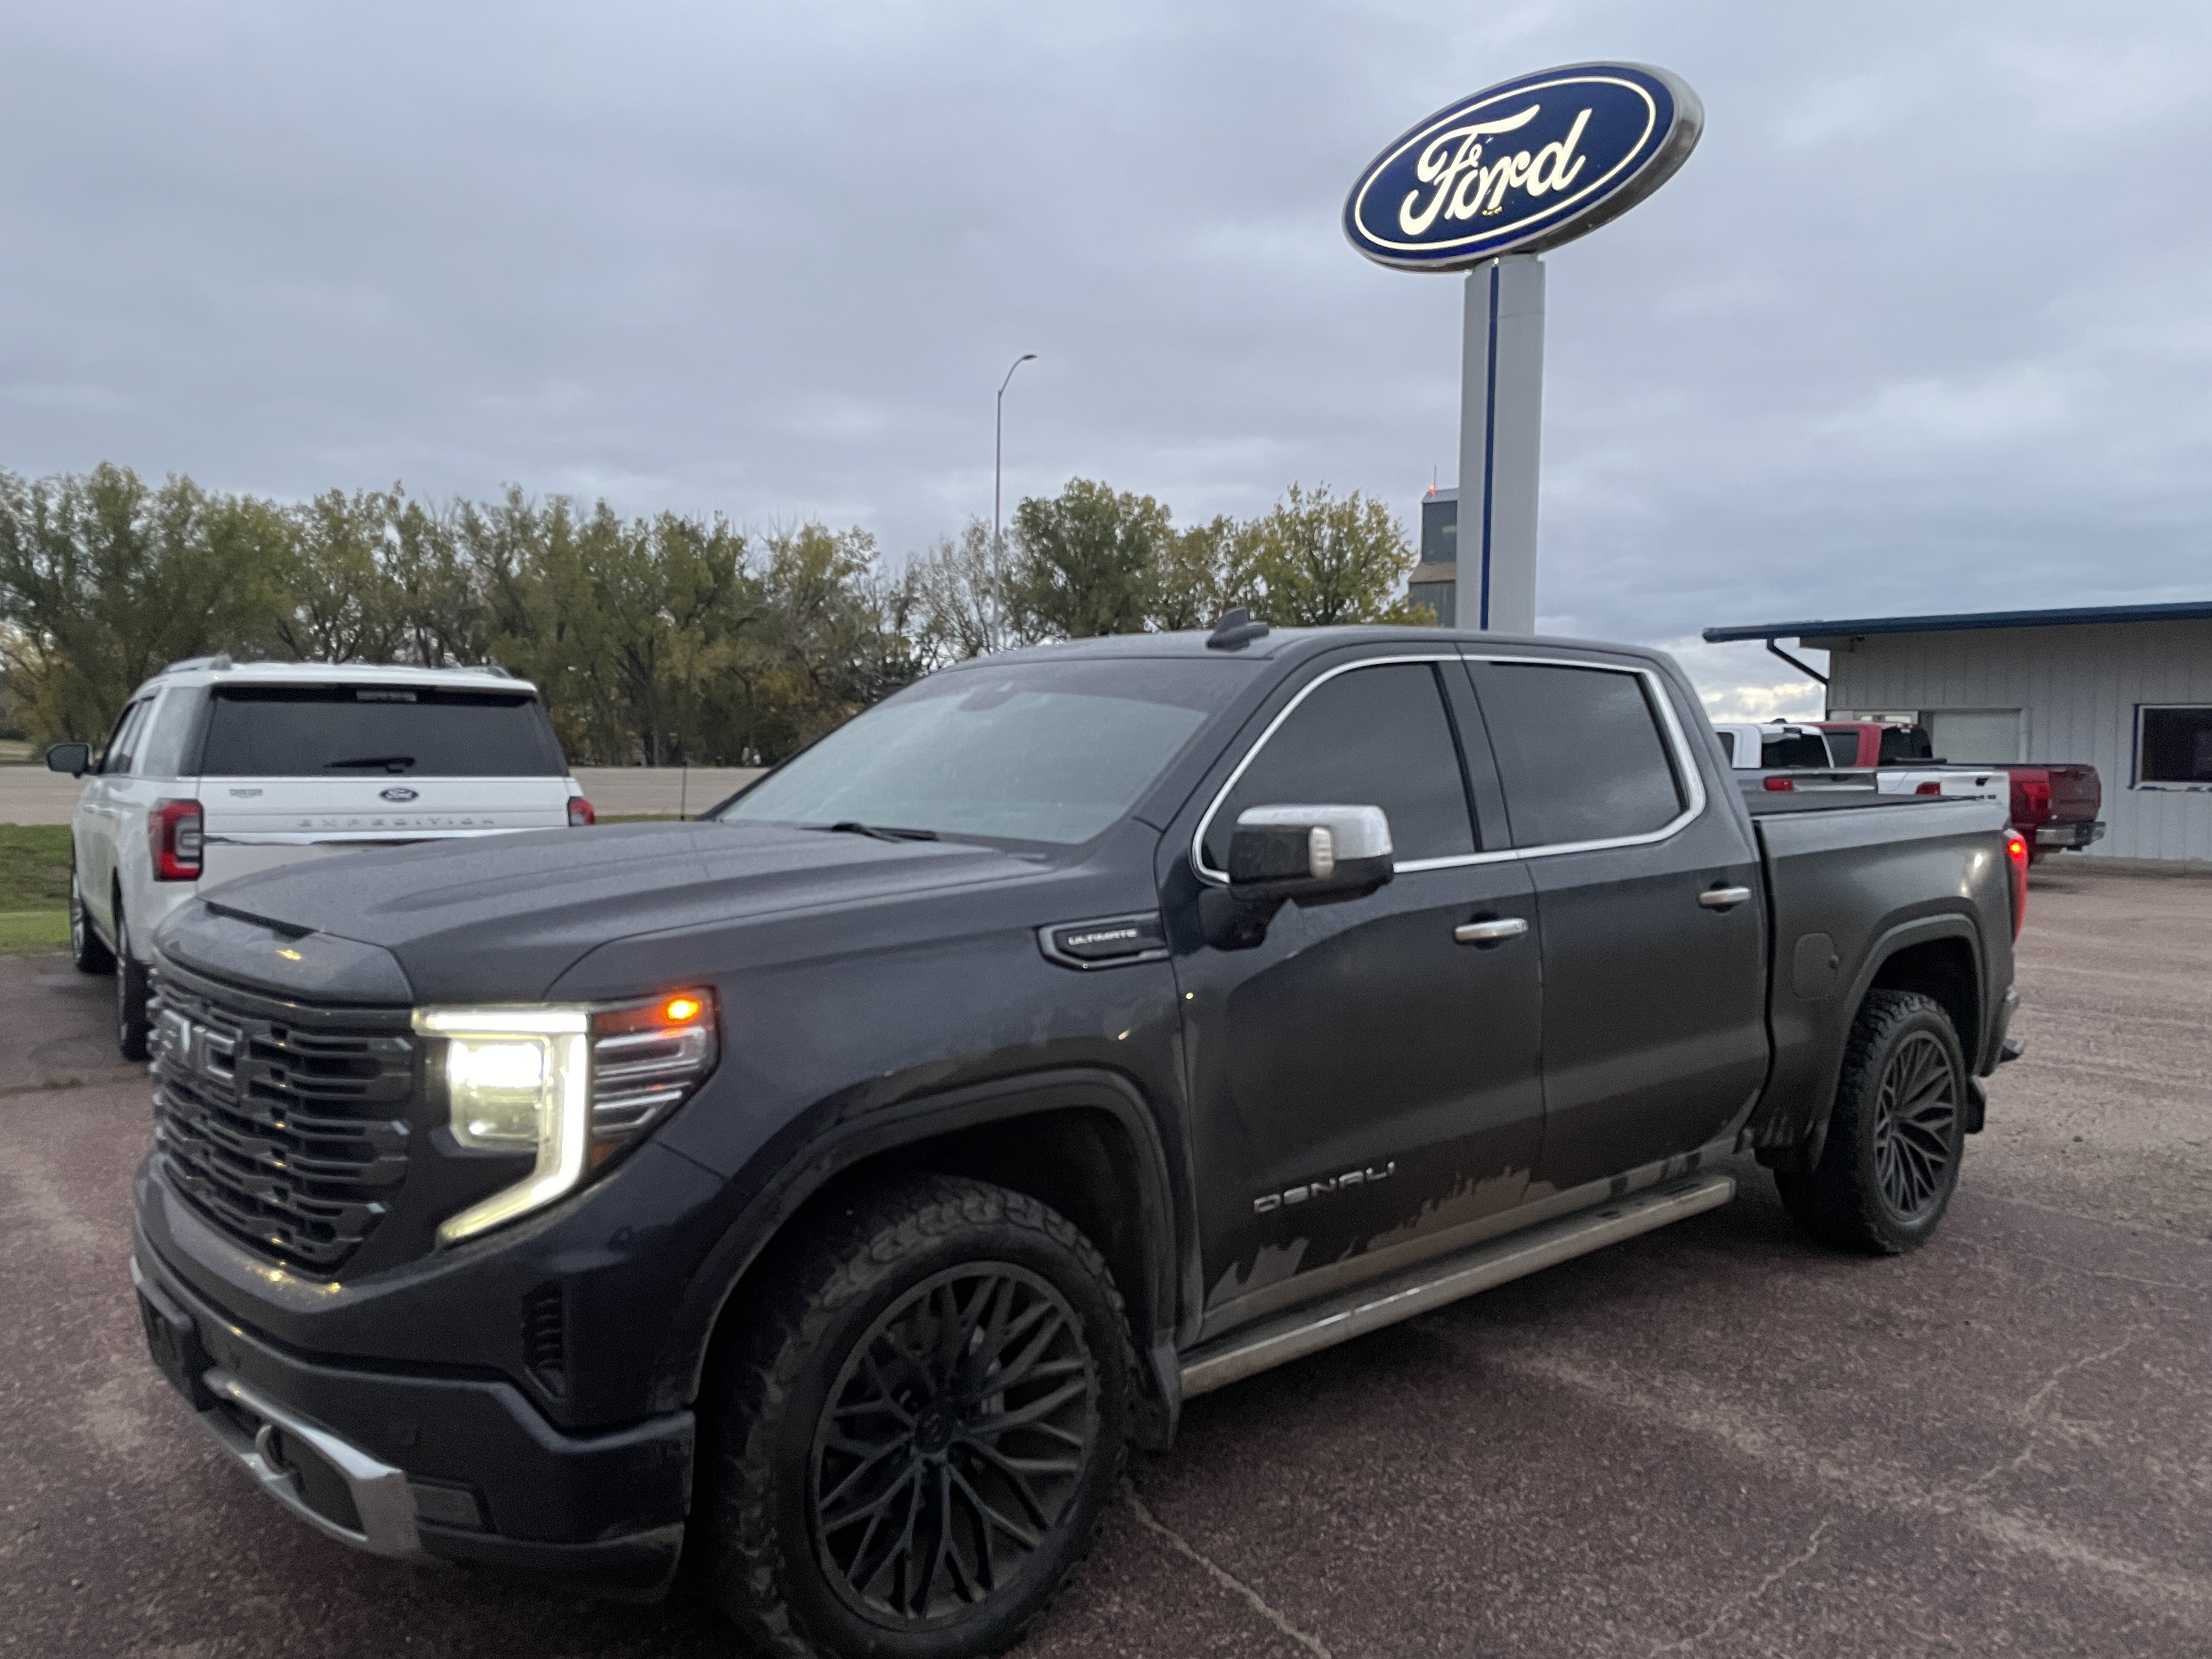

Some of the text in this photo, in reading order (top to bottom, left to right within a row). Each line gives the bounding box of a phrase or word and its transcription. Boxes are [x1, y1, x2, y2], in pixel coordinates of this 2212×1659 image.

[1400, 104, 1592, 236] Ford
[386, 789, 413, 799] Ford
[299, 816, 494, 827] EXPEDITION
[1068, 928, 1137, 945] ULTIMATE
[1254, 1160, 1396, 1214] DENALI
